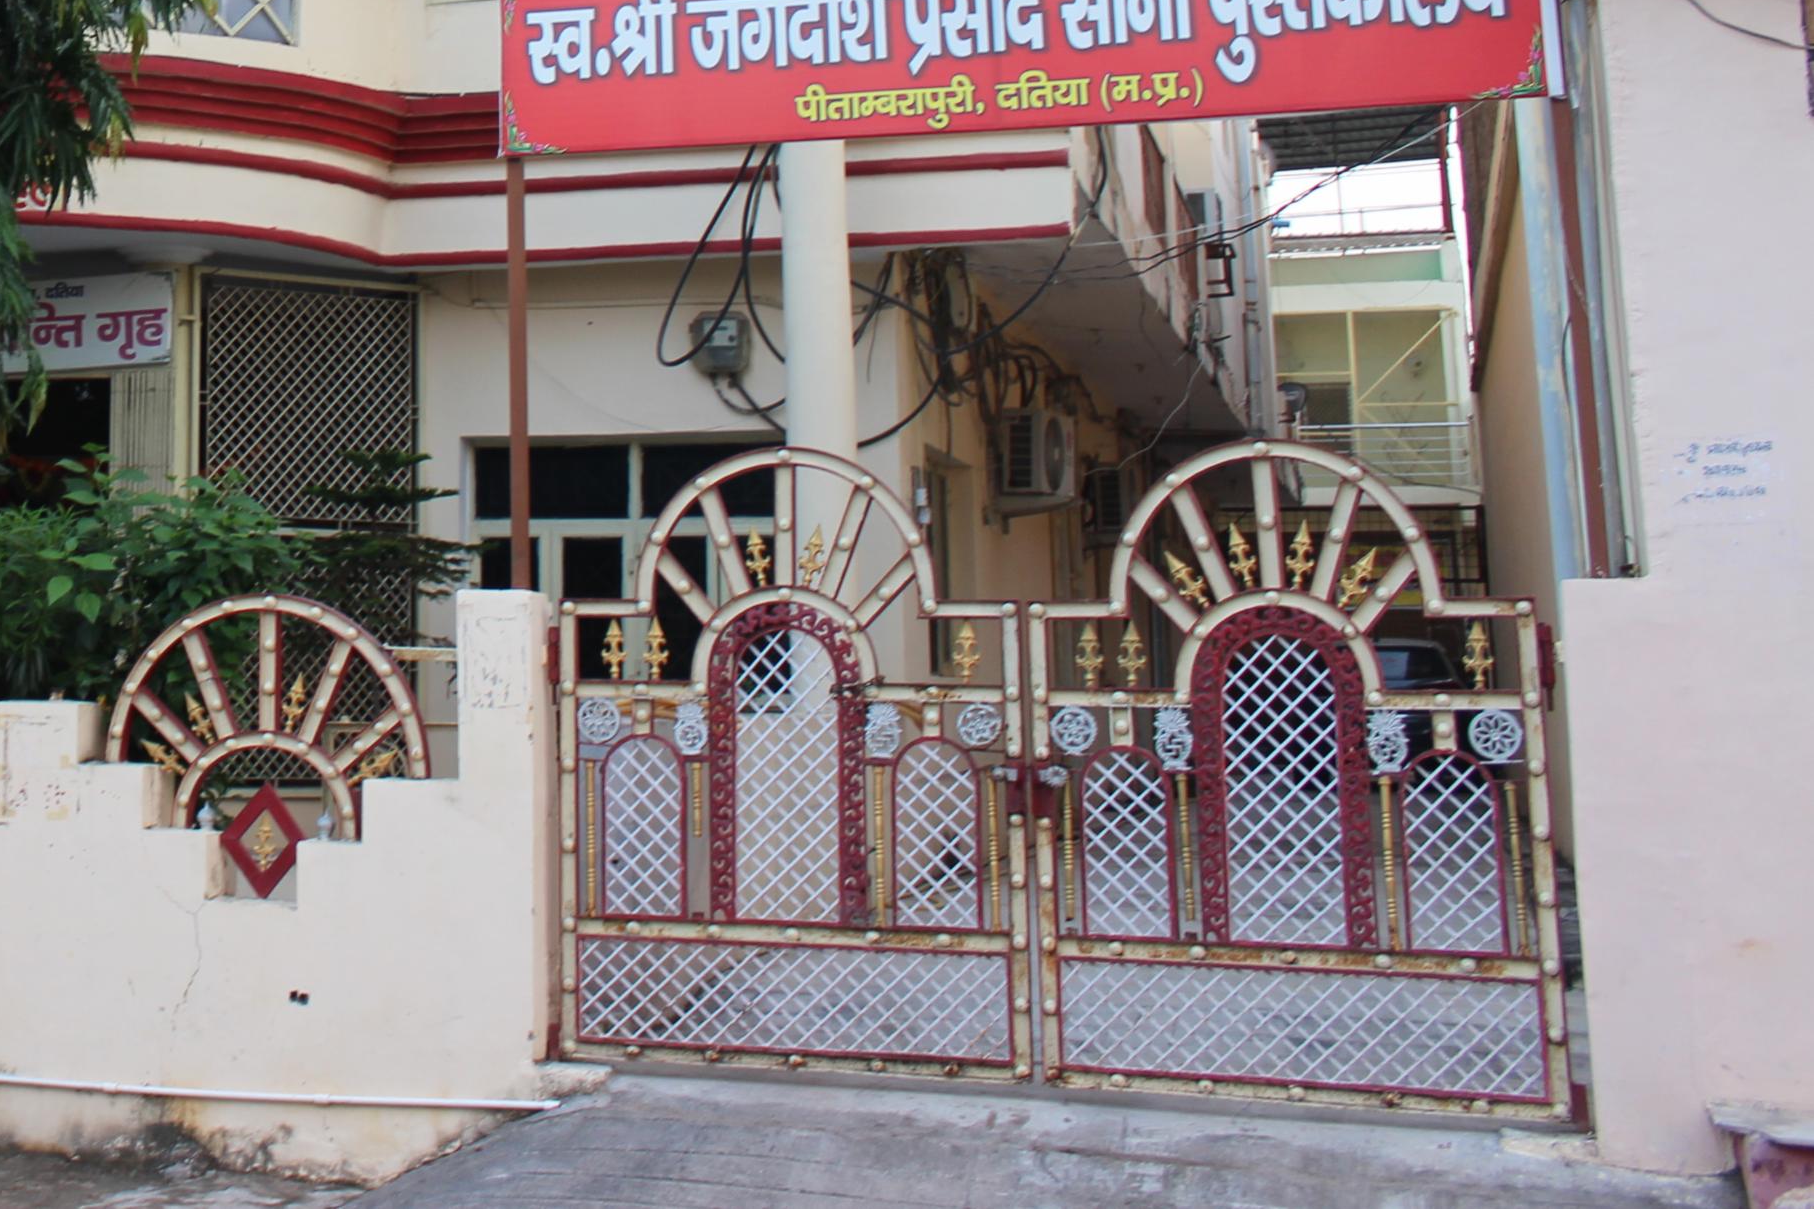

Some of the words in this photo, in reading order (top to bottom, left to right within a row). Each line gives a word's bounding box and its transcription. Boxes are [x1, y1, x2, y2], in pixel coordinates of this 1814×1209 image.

[794, 74, 986, 130] पीताम्बरापुरी,
[994, 69, 1090, 111] दतिया
[1099, 67, 1204, 113] (म.प्र.)
[95, 307, 168, 360] गृह
